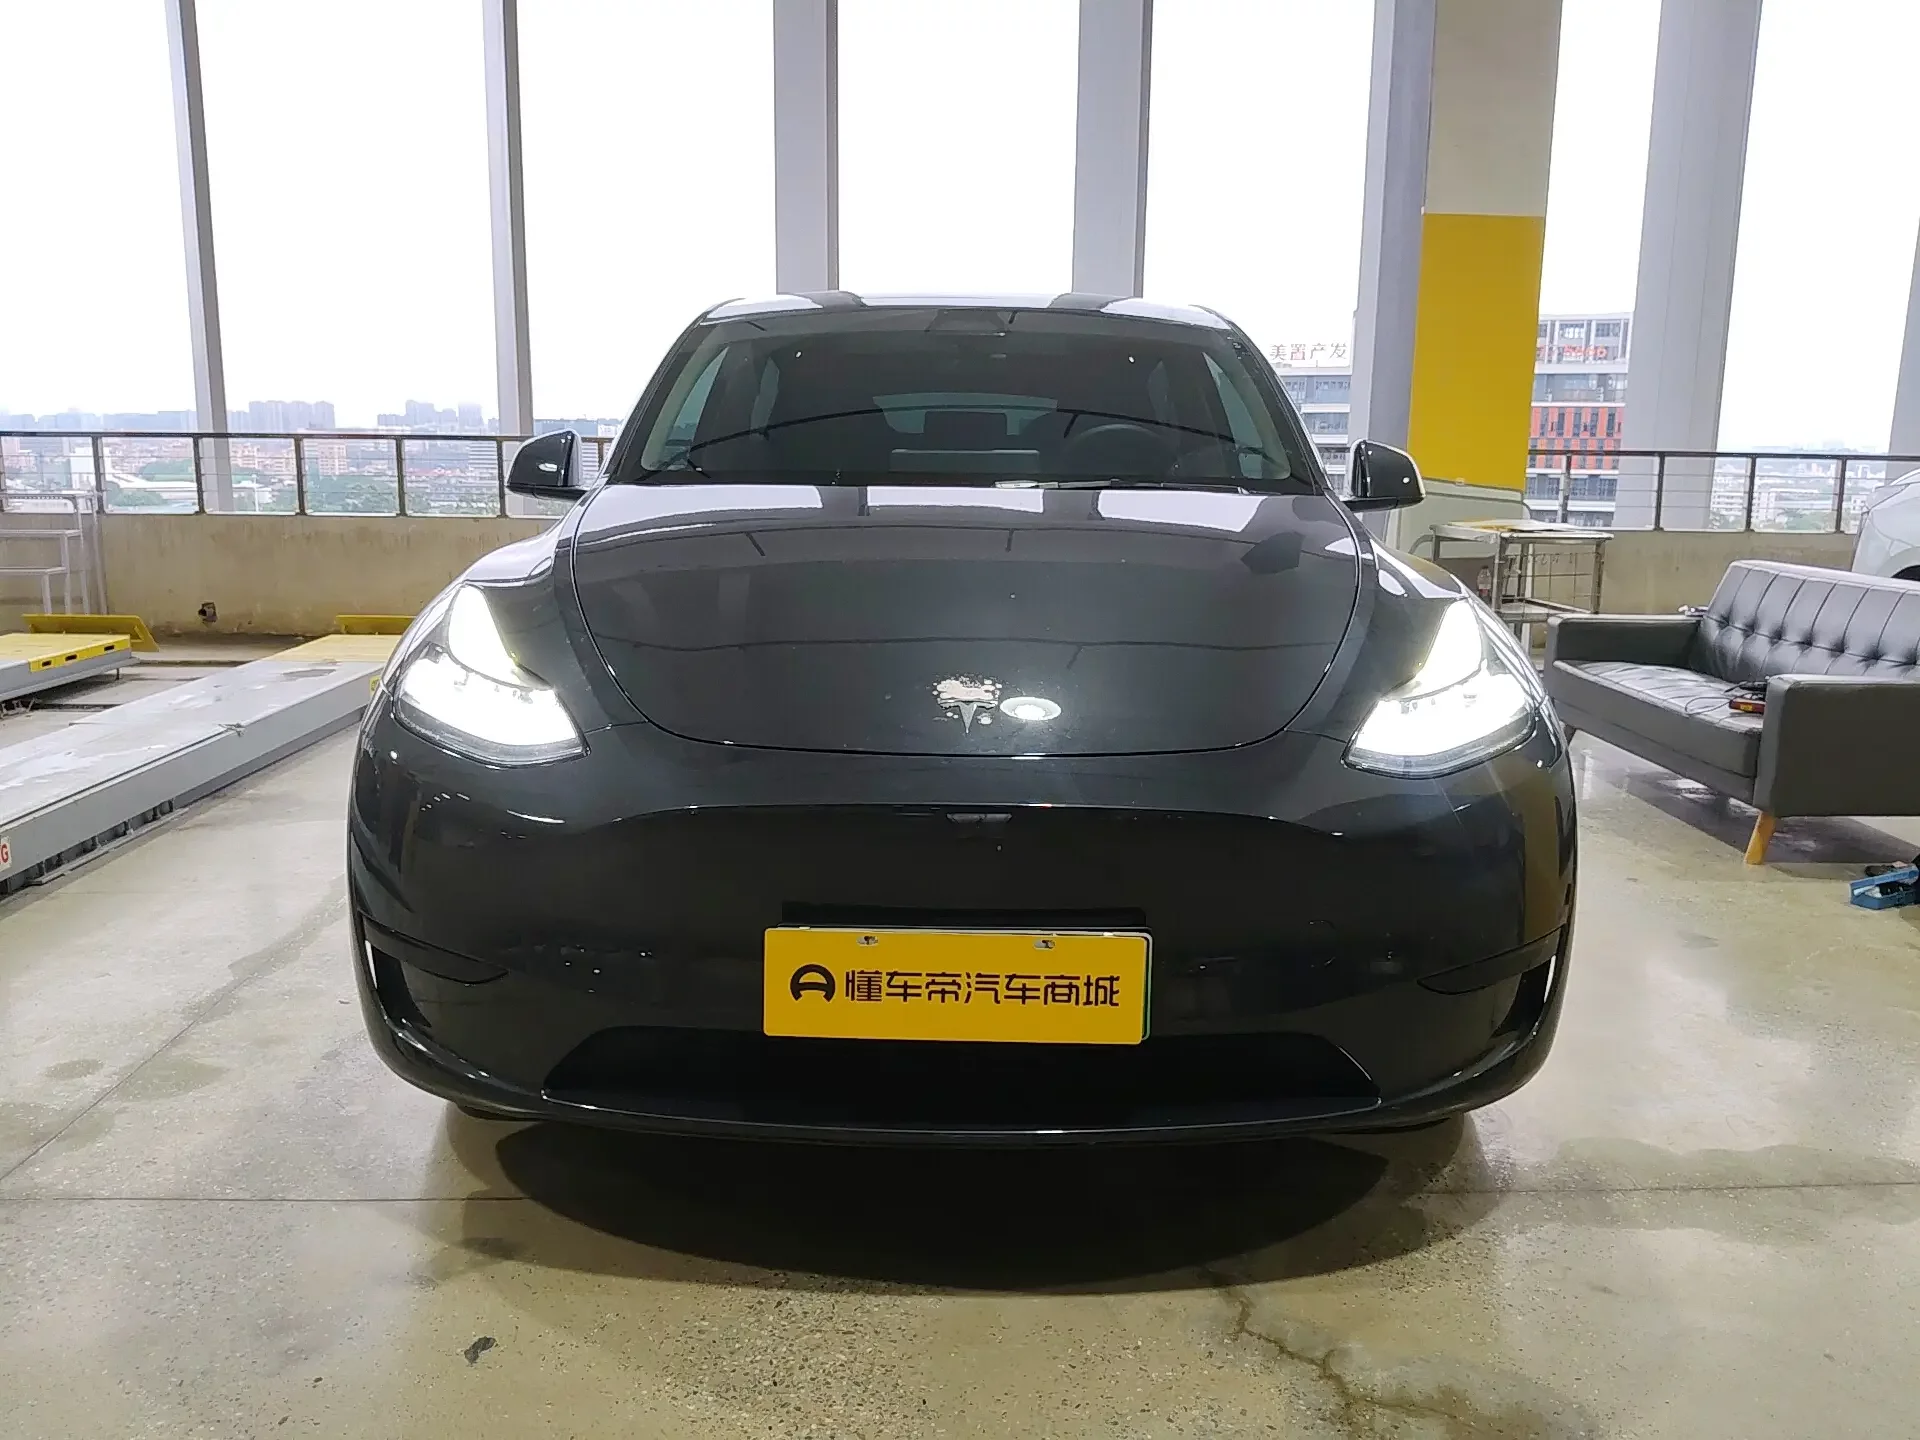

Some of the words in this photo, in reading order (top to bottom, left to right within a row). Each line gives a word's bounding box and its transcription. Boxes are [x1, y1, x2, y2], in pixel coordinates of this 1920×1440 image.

[845, 969, 1120, 1007] 懂车帝汽车商城
